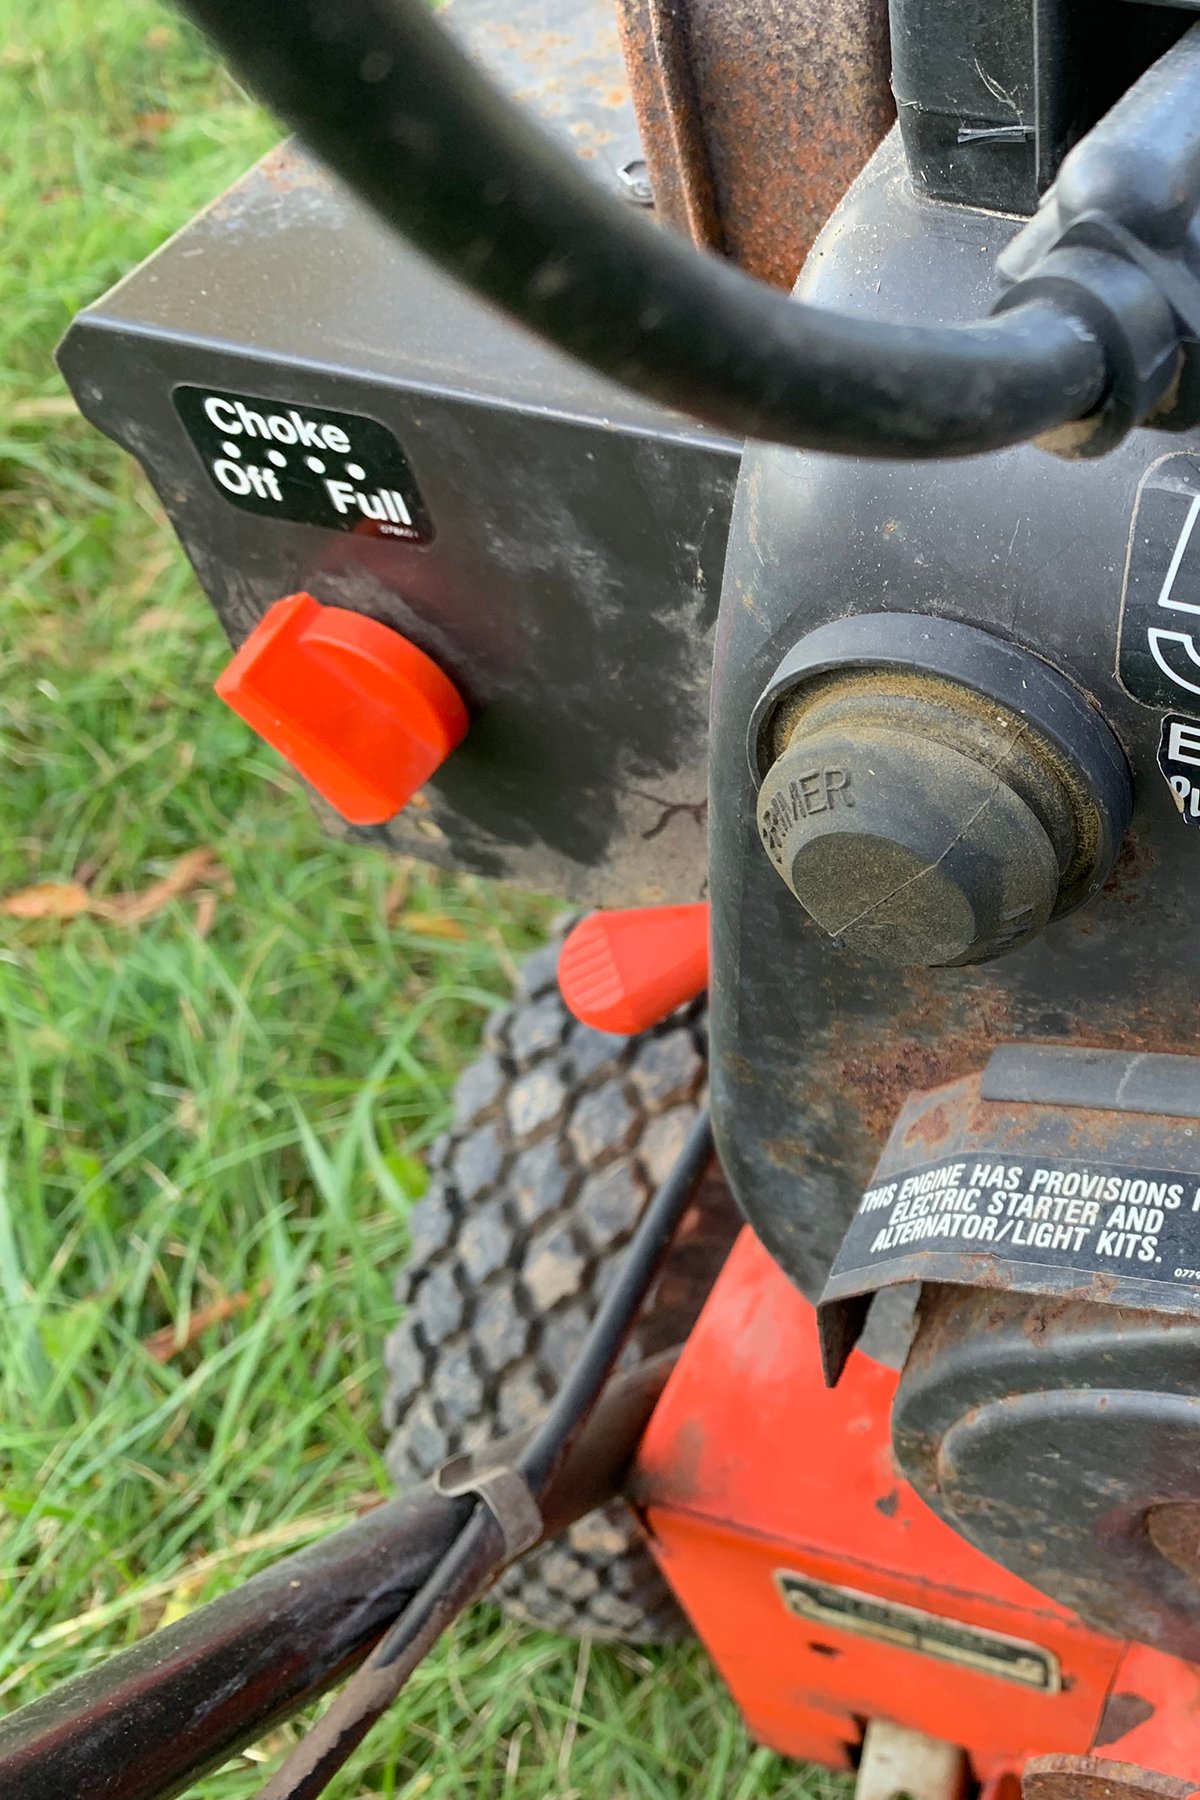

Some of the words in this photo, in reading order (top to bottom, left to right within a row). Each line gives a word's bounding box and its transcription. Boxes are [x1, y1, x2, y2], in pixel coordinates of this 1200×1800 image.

[204, 396, 352, 454] Choke
[213, 458, 283, 502] Off
[323, 478, 412, 526] Full
[859, 1182, 898, 1215] THIS
[898, 1163, 966, 1201] ENGINE
[969, 1163, 1023, 1191] HAS
[1031, 1168, 1182, 1209] PROVISIONS
[888, 1188, 981, 1226] ELECTRIC
[988, 1193, 1099, 1227] STARTER
[1106, 1205, 1165, 1235] AND
[870, 1212, 1091, 1254] ALTERNATOR/LIGHT
[1096, 1235, 1163, 1264] KITS.
